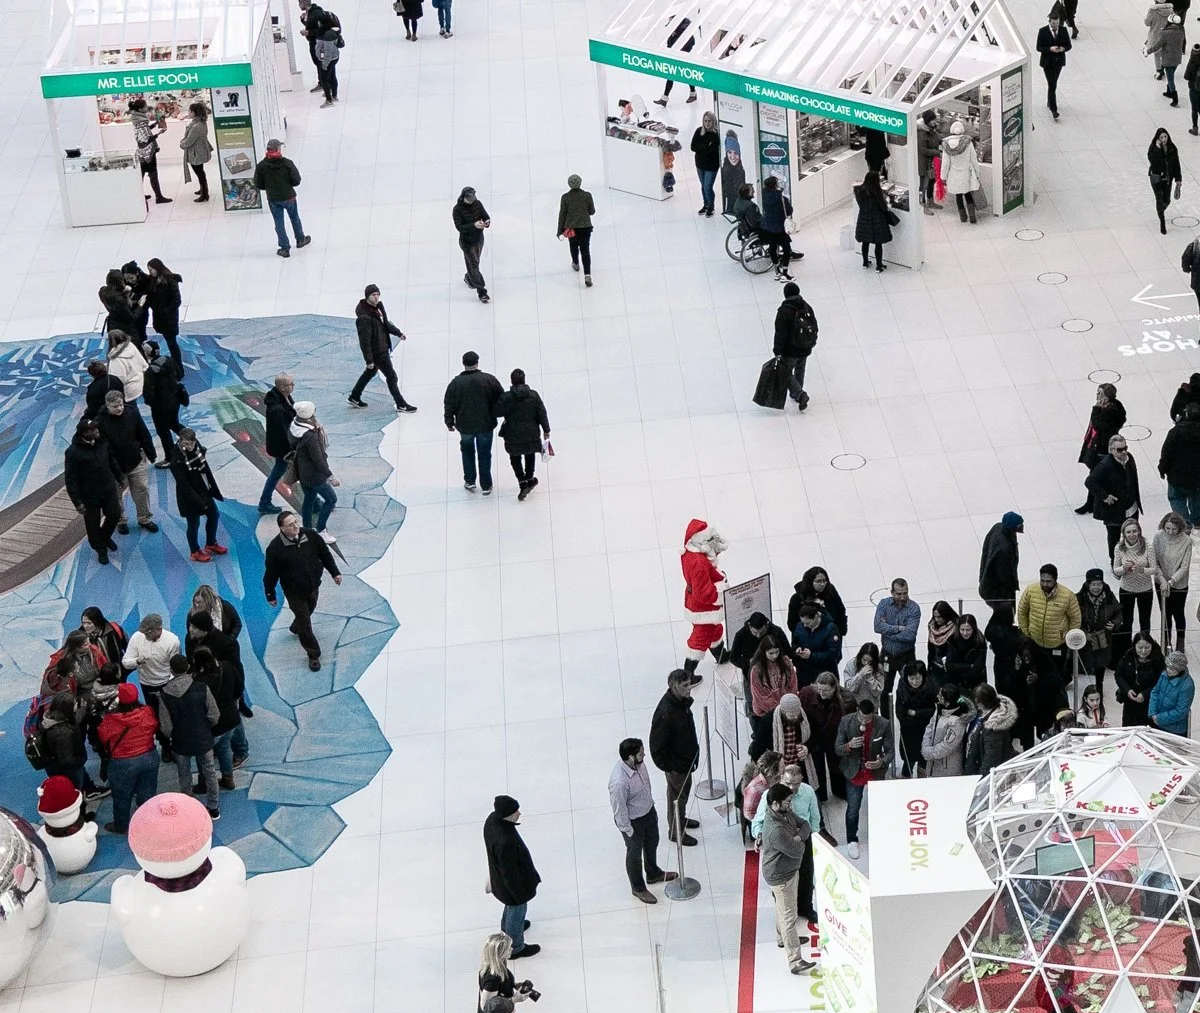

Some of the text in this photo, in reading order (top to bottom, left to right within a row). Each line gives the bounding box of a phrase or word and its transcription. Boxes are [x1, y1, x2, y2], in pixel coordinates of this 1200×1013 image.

[97, 73, 198, 90] MR. ELLIE POOH
[622, 53, 705, 82] FLOGA NEW YORK
[745, 82, 761, 95] THE
[761, 87, 800, 104] AMAZING
[799, 96, 851, 117] CHOCOLATE
[853, 109, 904, 128] WORKSHOP
[906, 799, 929, 872] GIVE JOY.
[824, 908, 848, 938] GIVE
